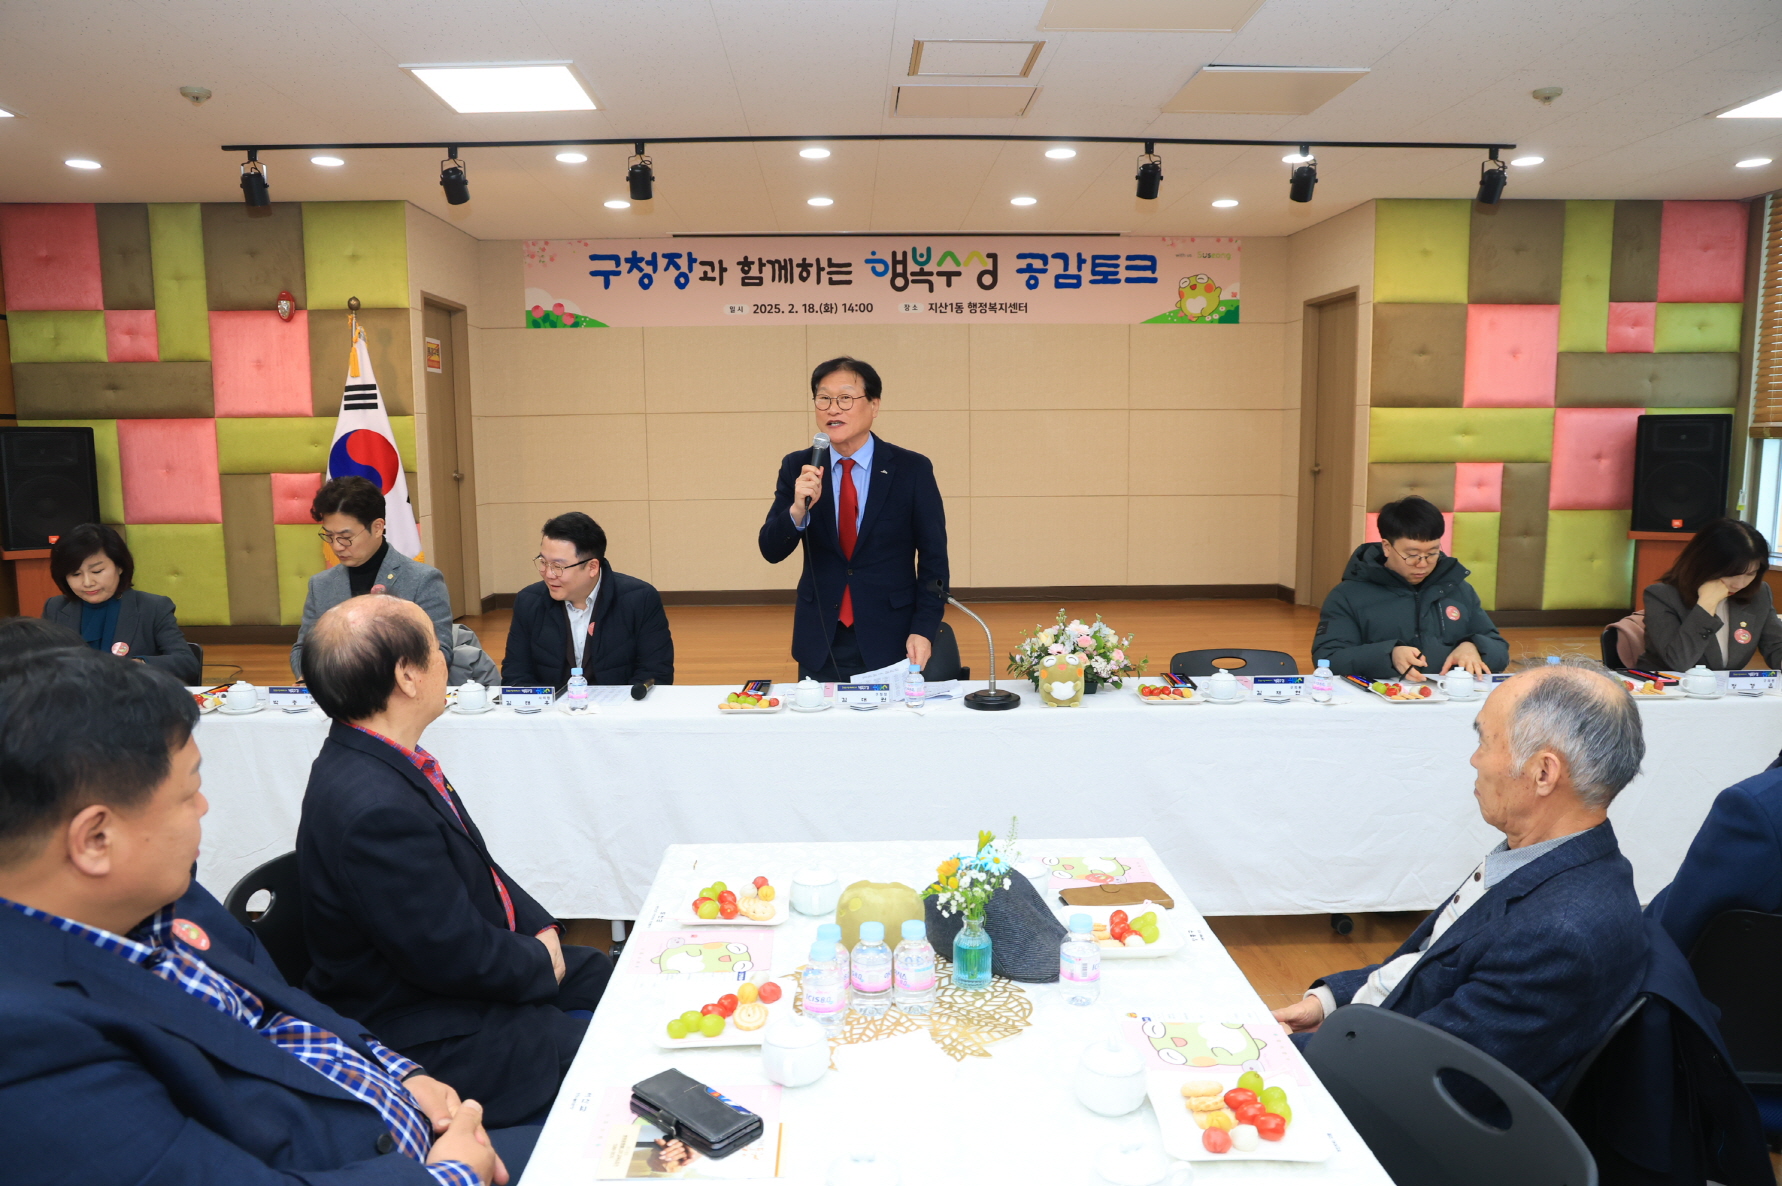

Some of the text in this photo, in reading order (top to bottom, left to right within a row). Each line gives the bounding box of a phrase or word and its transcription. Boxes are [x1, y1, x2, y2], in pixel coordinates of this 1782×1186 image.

[588, 246, 1158, 293] 구청장과 함께하는 행복수성 공감토크
[752, 303, 785, 314] 2025.
[788, 303, 799, 314] 2.
[801, 302, 838, 315] 18.(화)
[841, 302, 873, 313] 14:00
[928, 302, 965, 314] 지산1동
[967, 301, 1028, 314] 행정복지센터
